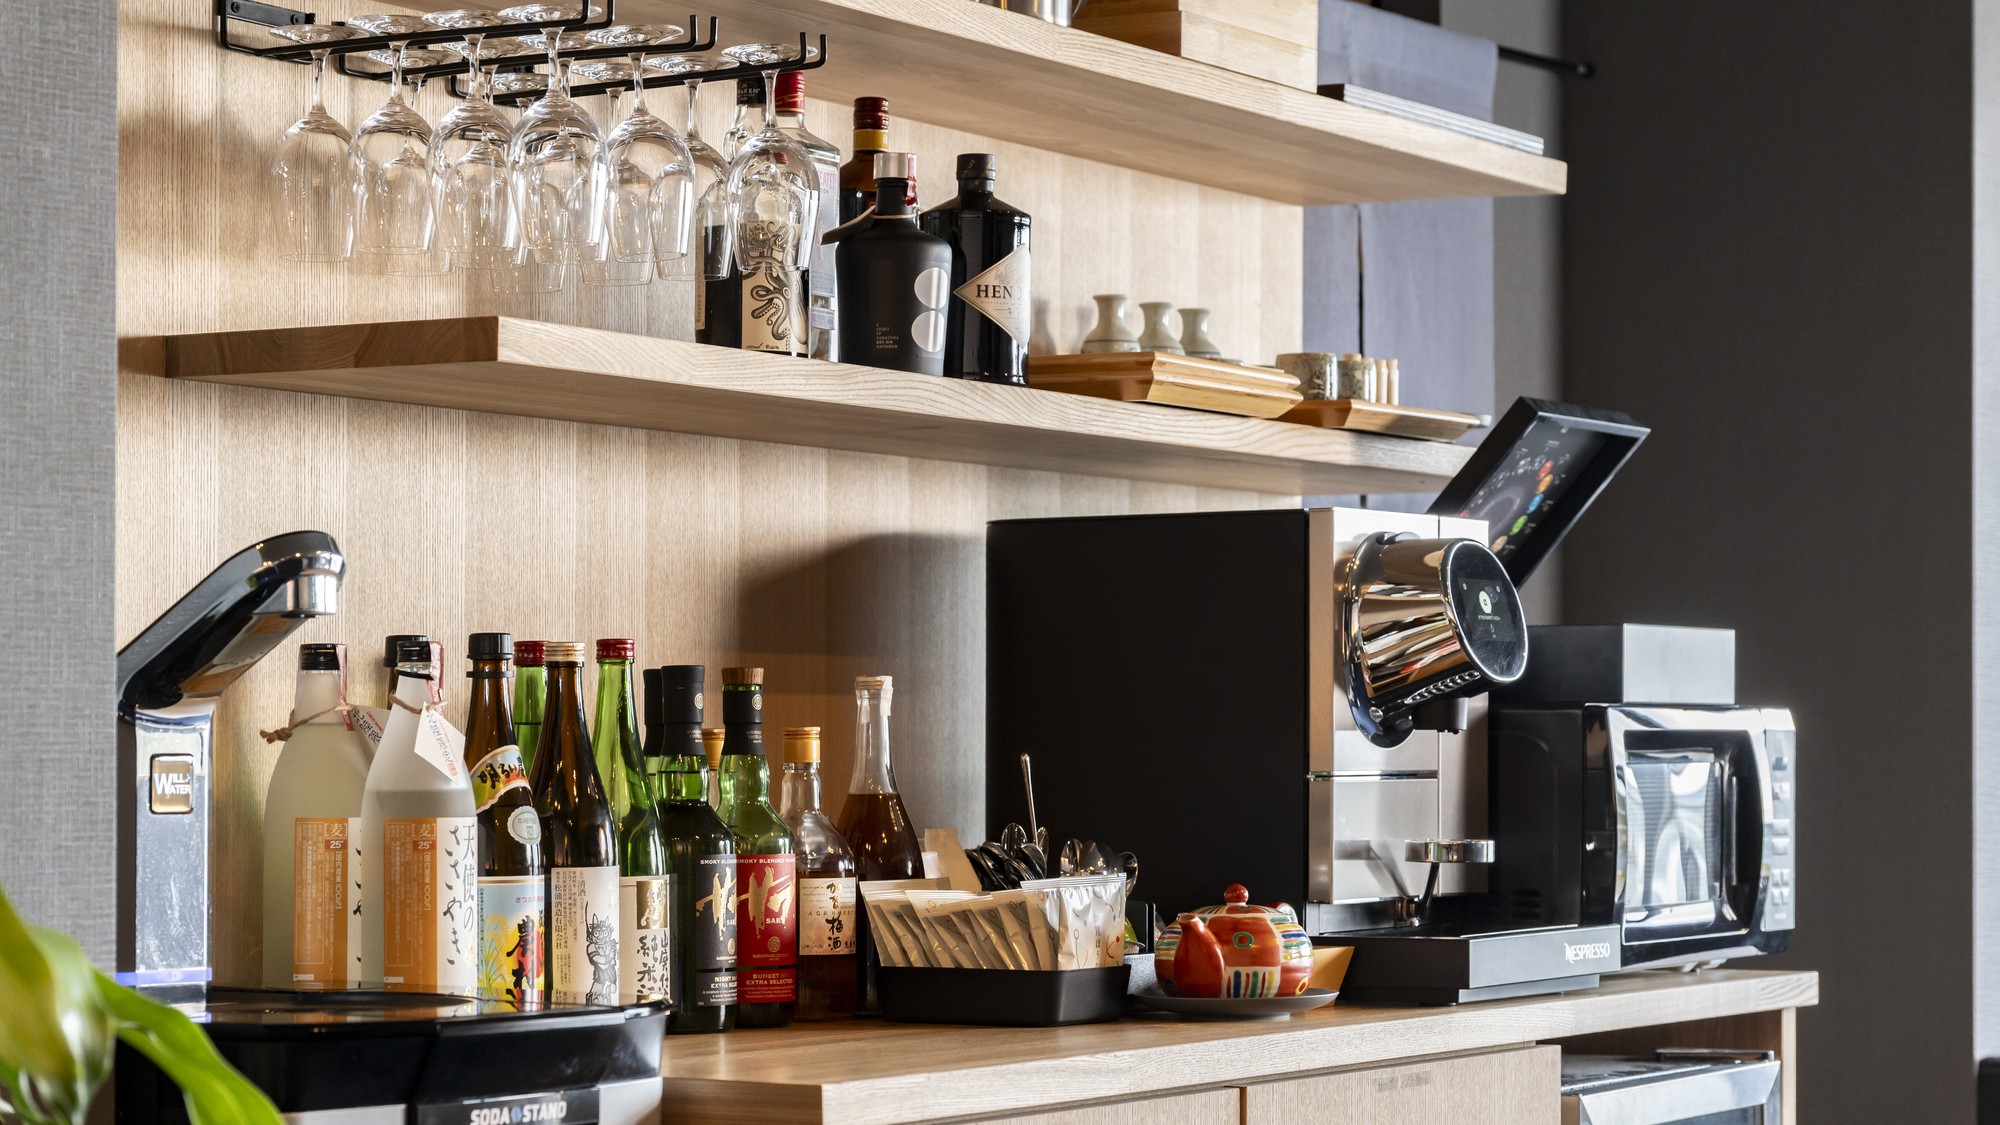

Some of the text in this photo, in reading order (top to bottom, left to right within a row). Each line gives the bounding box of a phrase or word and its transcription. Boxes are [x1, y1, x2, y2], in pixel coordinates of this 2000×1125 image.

[1563, 943, 1611, 964] NESPRESSO
[470, 1101, 567, 1125] SODA STAND
